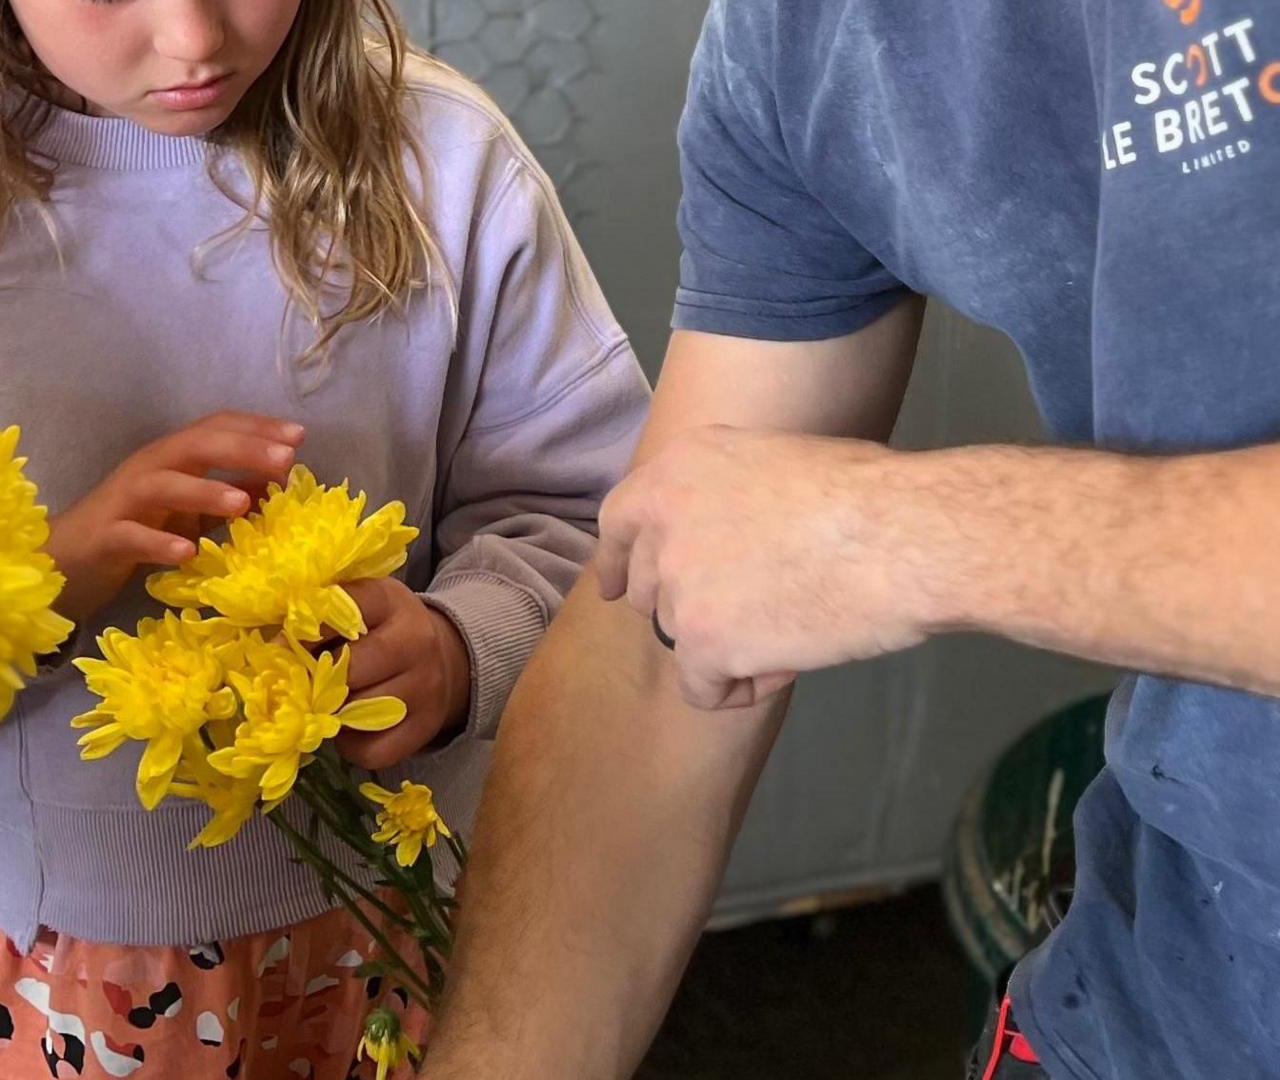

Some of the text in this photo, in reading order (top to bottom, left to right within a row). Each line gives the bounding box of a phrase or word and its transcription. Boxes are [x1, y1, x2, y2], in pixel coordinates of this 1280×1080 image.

[1131, 18, 1256, 105] SCOTT
[1102, 121, 1137, 170] LE
[1181, 139, 1252, 174] LIMITED
